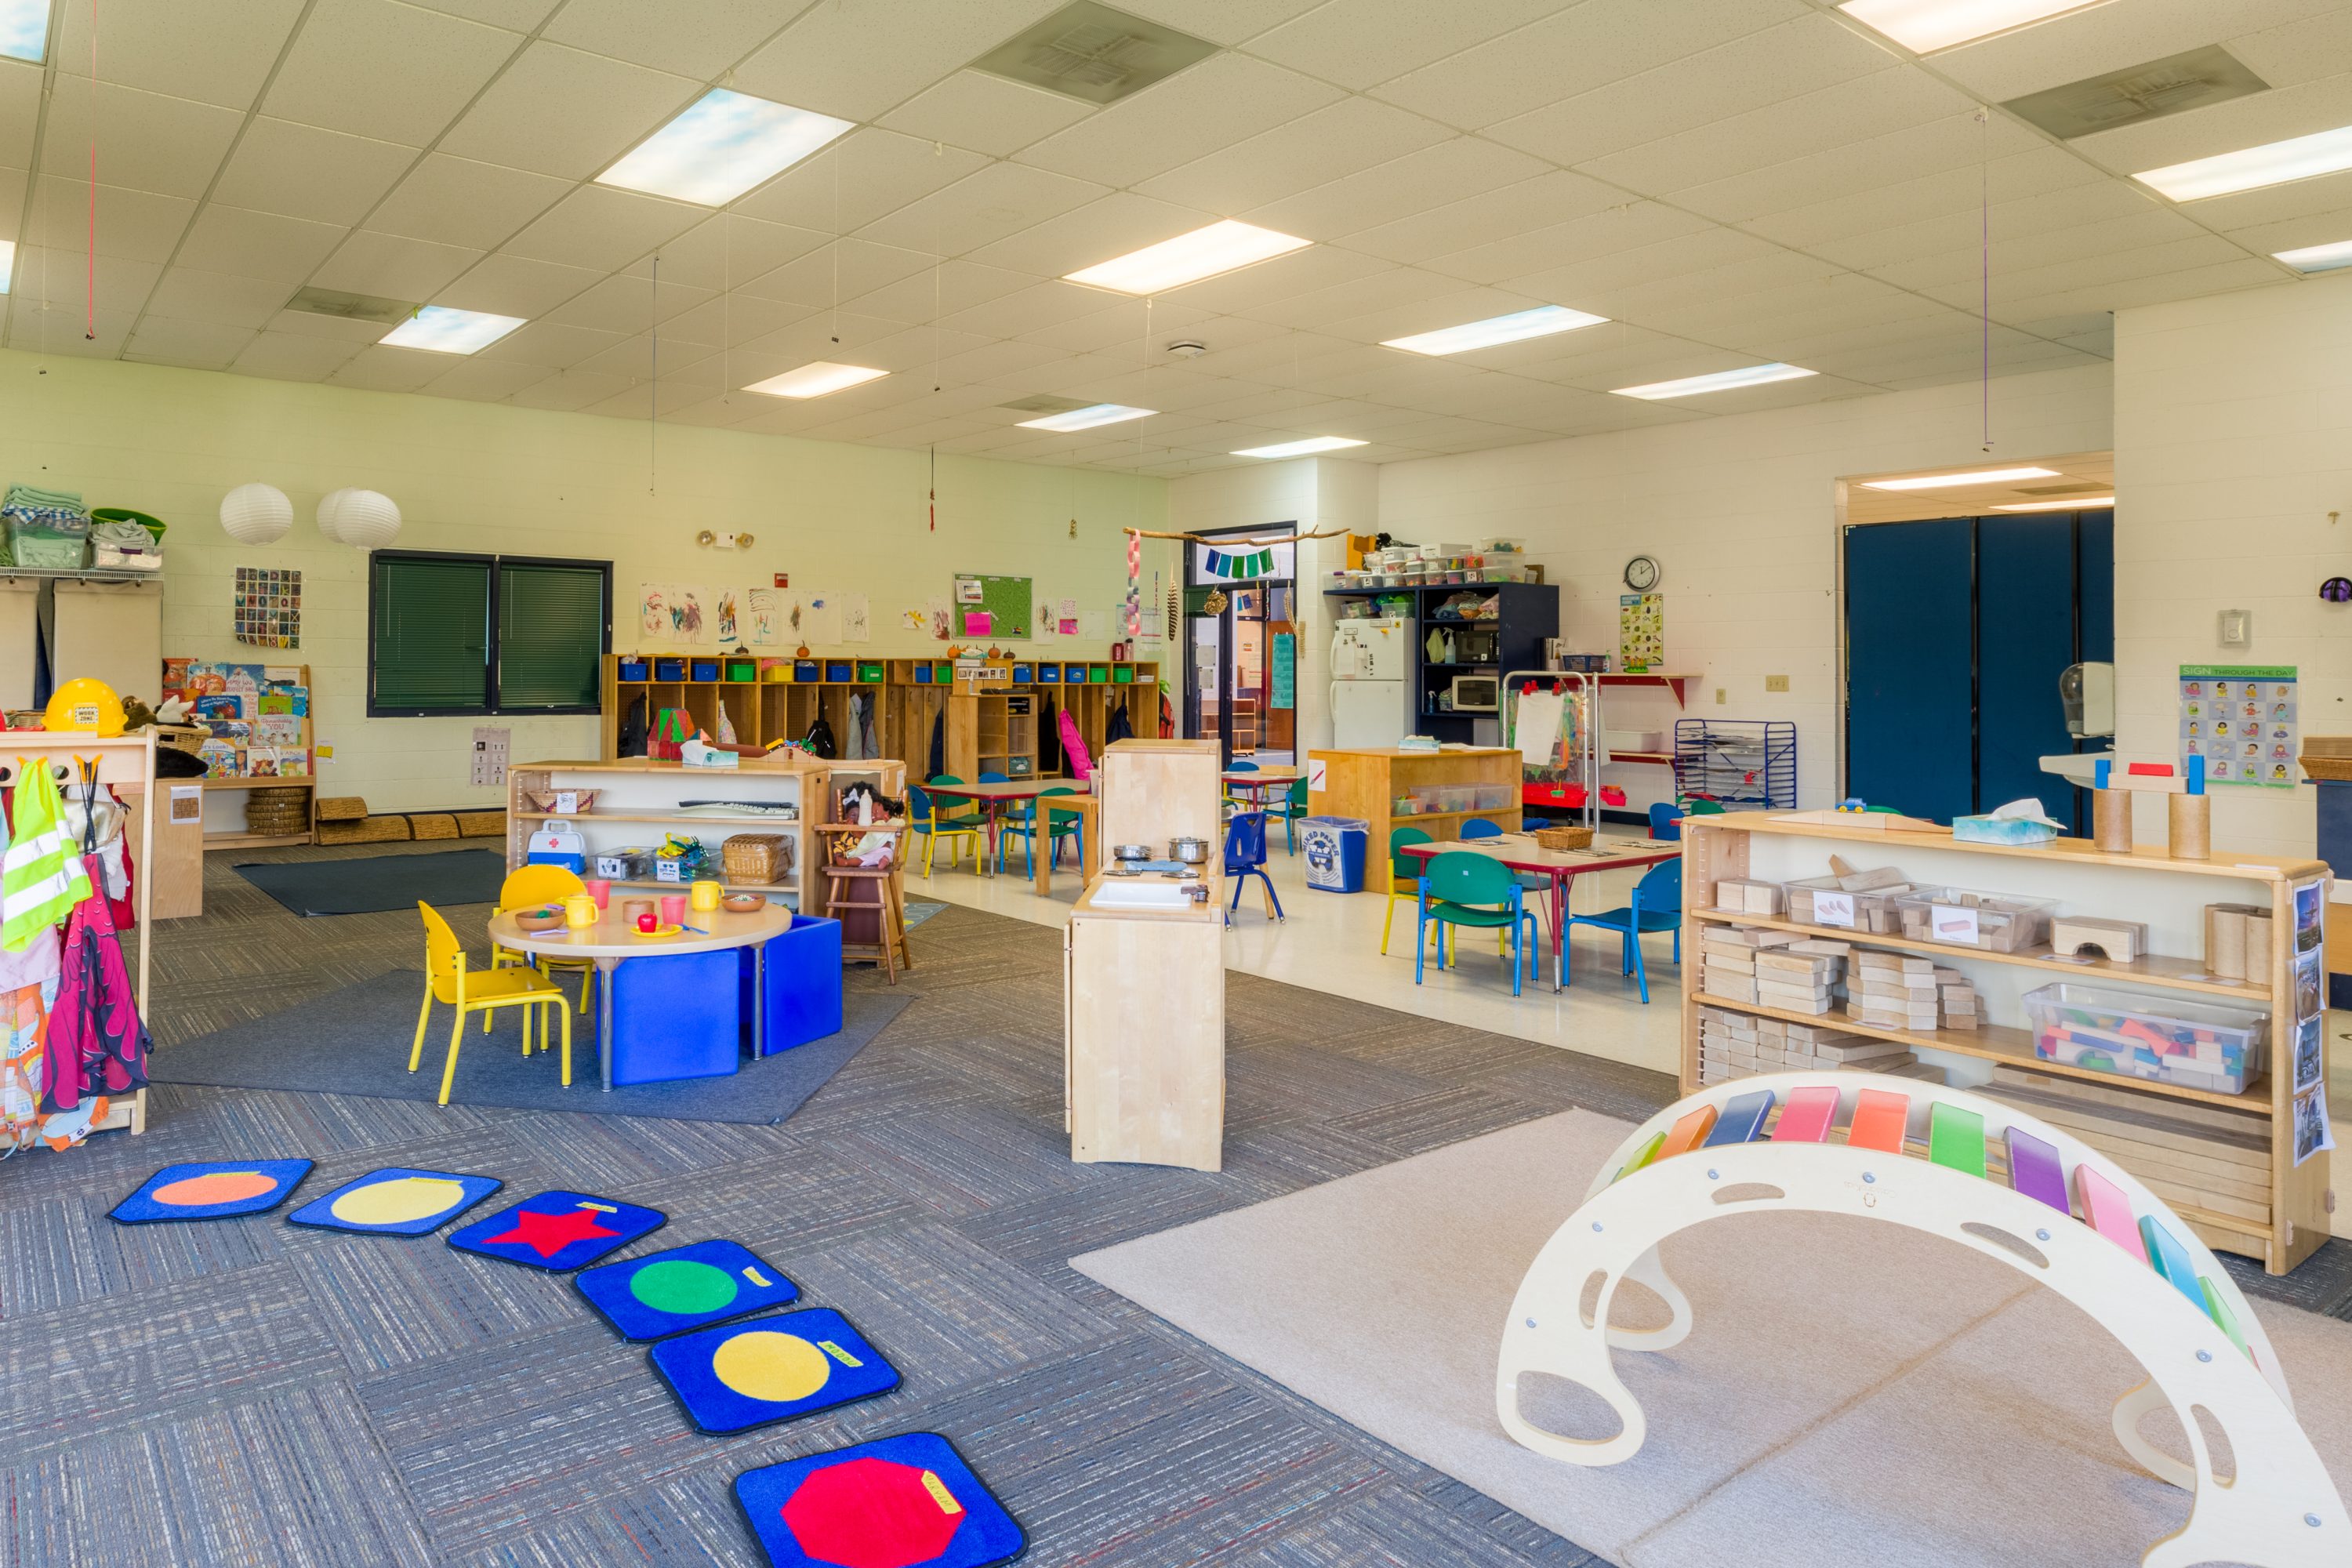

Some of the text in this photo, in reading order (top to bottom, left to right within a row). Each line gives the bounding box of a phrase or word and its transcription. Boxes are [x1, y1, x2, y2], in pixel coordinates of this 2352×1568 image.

[2183, 666, 2211, 675] SIGN
[1303, 831, 1340, 857] MIXED PAPER
[825, 1344, 858, 1366] MODOU
